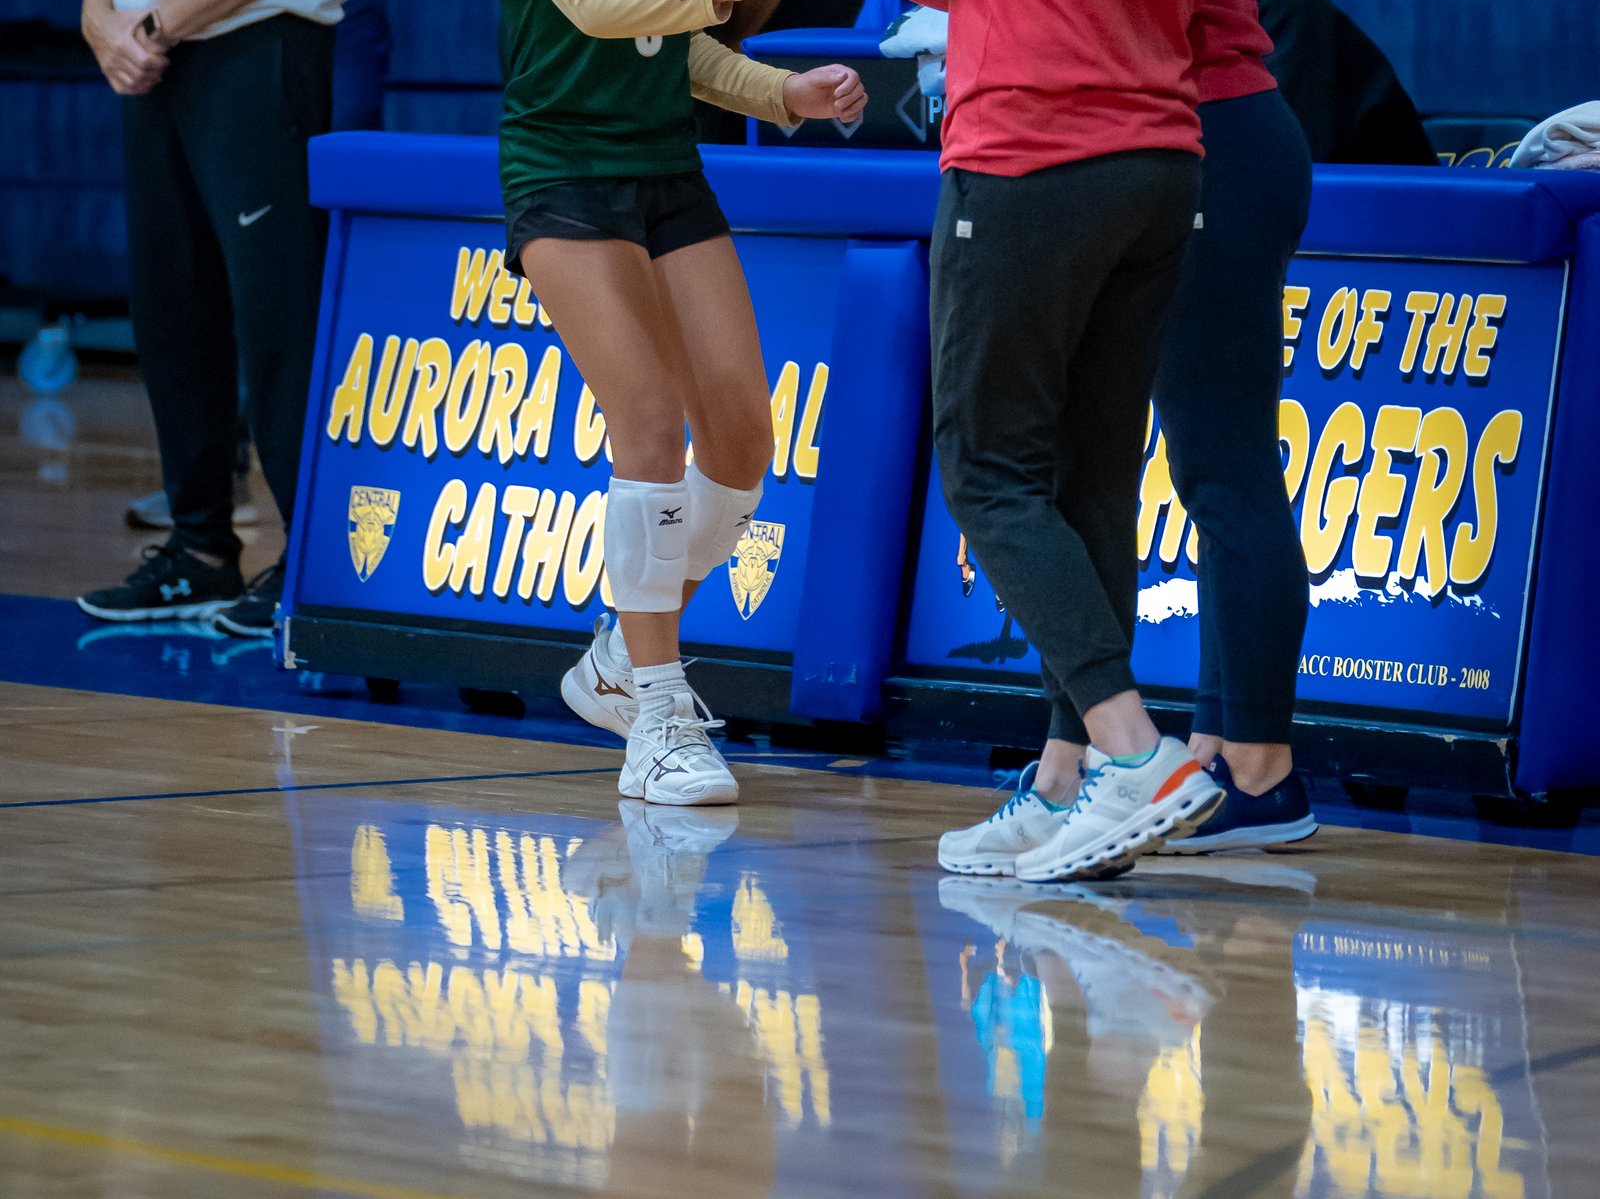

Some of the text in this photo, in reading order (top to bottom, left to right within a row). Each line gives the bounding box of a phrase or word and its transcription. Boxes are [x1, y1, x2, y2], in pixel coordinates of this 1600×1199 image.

[1317, 286, 1392, 371] OF
[1398, 291, 1507, 378] THE
[326, 333, 562, 464] AURORA
[422, 478, 618, 607] CATHO
[1297, 653, 1331, 677] ACC
[1332, 656, 1404, 683] BOOSTER
[1406, 662, 1449, 687] CLUB
[1459, 667, 1491, 690] 2008
